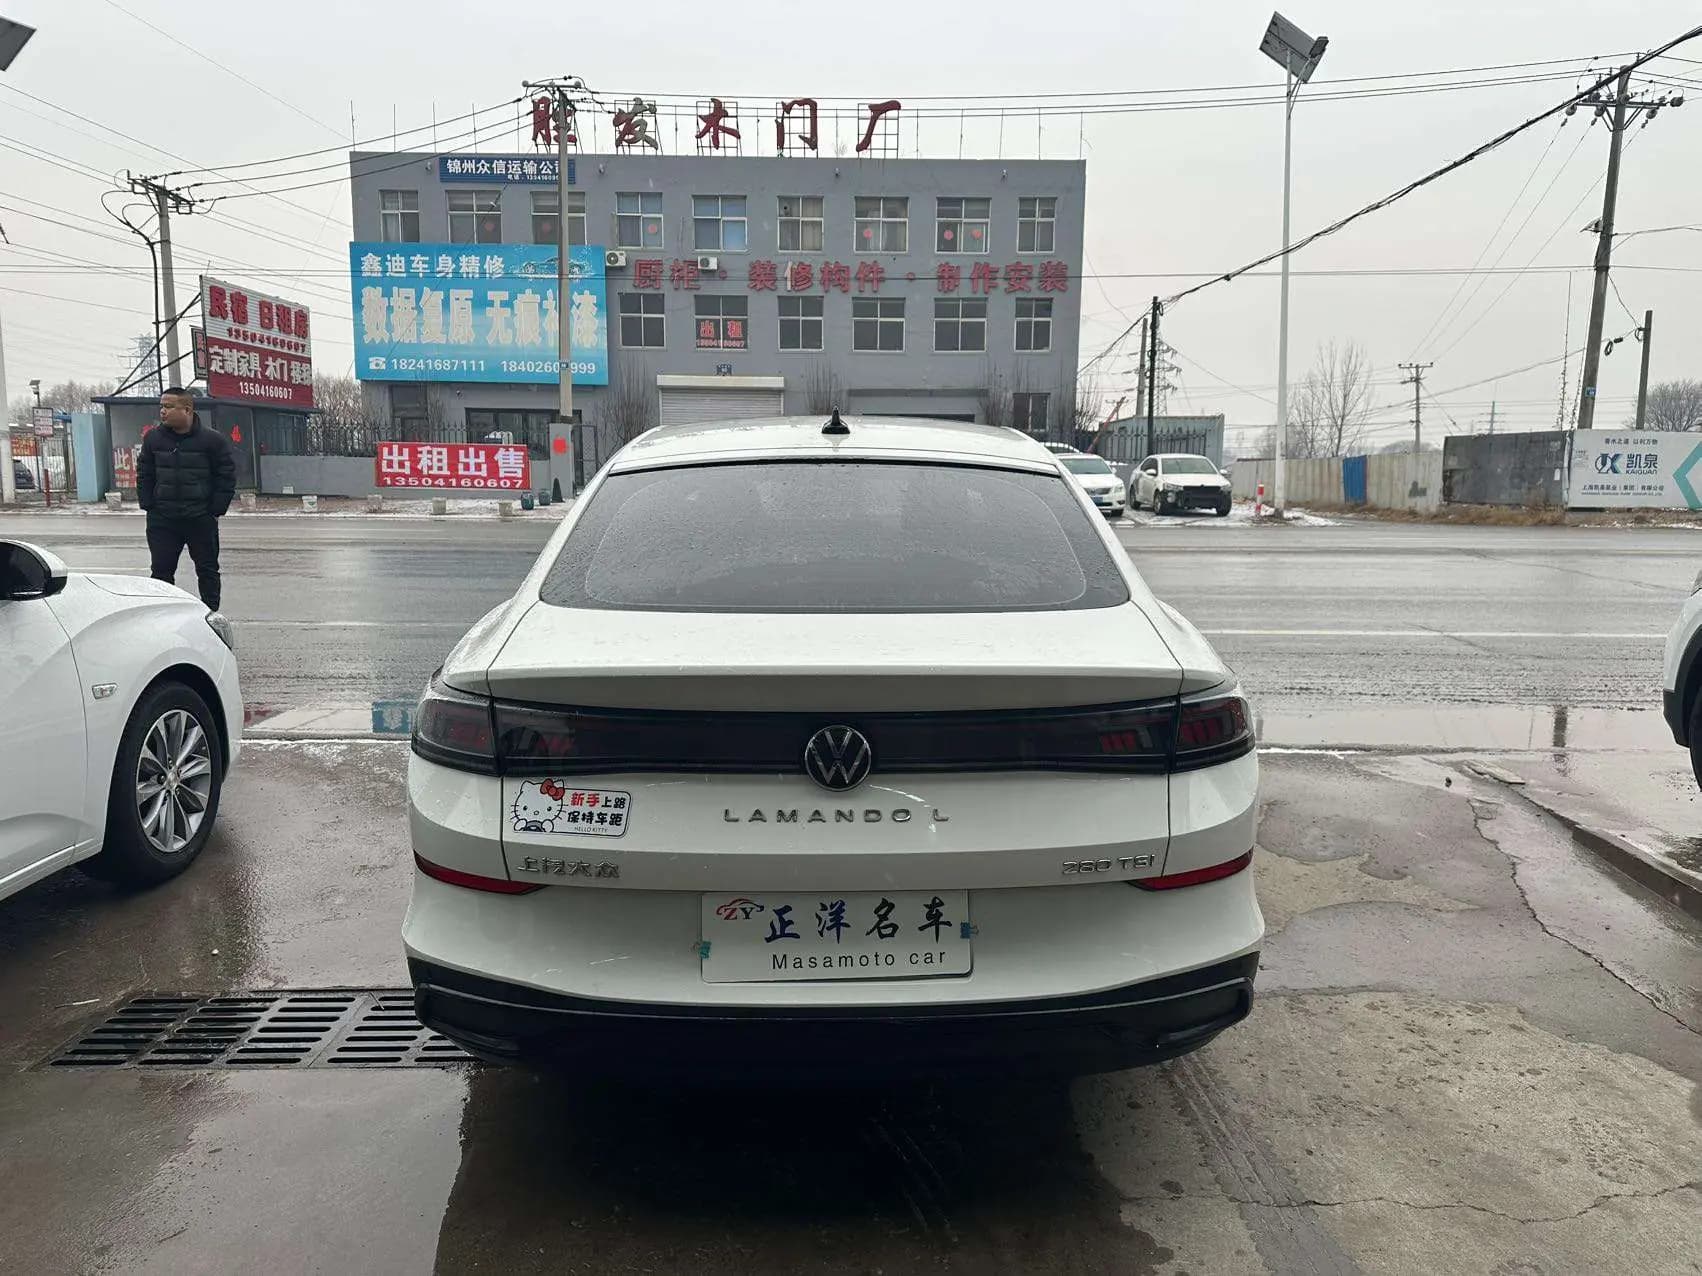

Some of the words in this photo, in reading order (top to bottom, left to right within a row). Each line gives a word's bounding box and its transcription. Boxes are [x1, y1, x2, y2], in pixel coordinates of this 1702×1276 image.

[446, 159, 559, 174] 锦州众信运输公
[360, 252, 504, 279] 鑫迪车身精修
[208, 285, 248, 325] 民宿
[258, 299, 309, 340] 日租房
[361, 286, 476, 344] 数据复原
[208, 345, 261, 379] 定制家具
[264, 356, 288, 382] 木门
[391, 358, 485, 372] 18241687111
[501, 360, 596, 374] 1840260999
[239, 381, 293, 400] 13504160607
[381, 444, 525, 478] 出租出售
[1626, 453, 1658, 469] 凯泉
[383, 477, 523, 488] 13504160607
[570, 791, 626, 809] 新手上路
[567, 810, 624, 827] 保持车距
[723, 808, 912, 823] LAMANDO
[932, 808, 949, 822] L
[1118, 854, 1155, 869] TSI
[723, 907, 754, 920] ZY
[764, 896, 952, 944] 正洋名车
[772, 953, 896, 969] Masamoto
[909, 950, 946, 965] car
